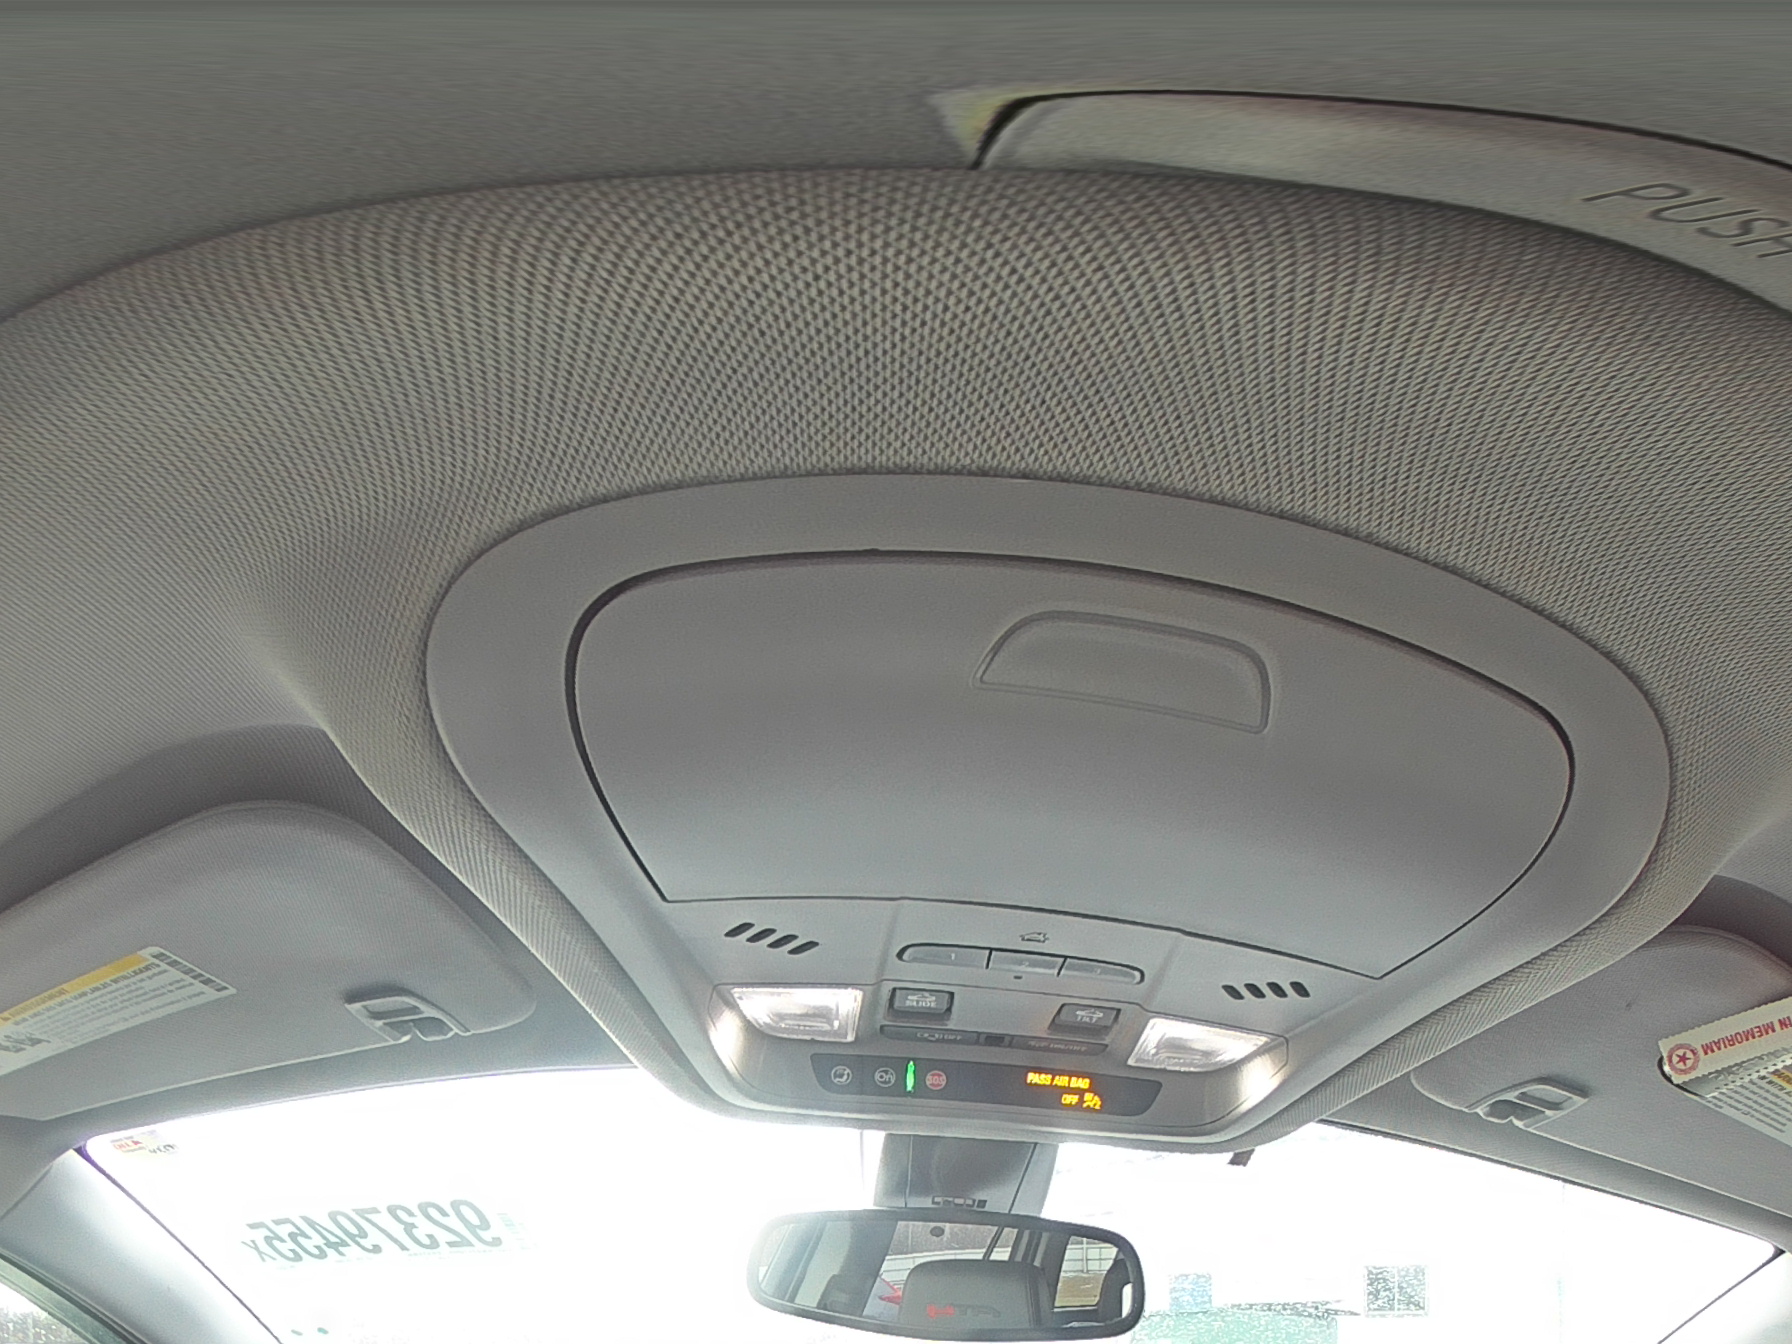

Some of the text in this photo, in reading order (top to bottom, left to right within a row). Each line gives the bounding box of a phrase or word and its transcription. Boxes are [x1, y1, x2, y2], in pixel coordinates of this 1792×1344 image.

[904, 999, 938, 1009] SLIDE
[1700, 1020, 1777, 1056] MEMORIAM
[927, 1074, 945, 1086] SOS
[1026, 1071, 1091, 1090] PASS AIR BAG
[1060, 1093, 1080, 1105] OFF
